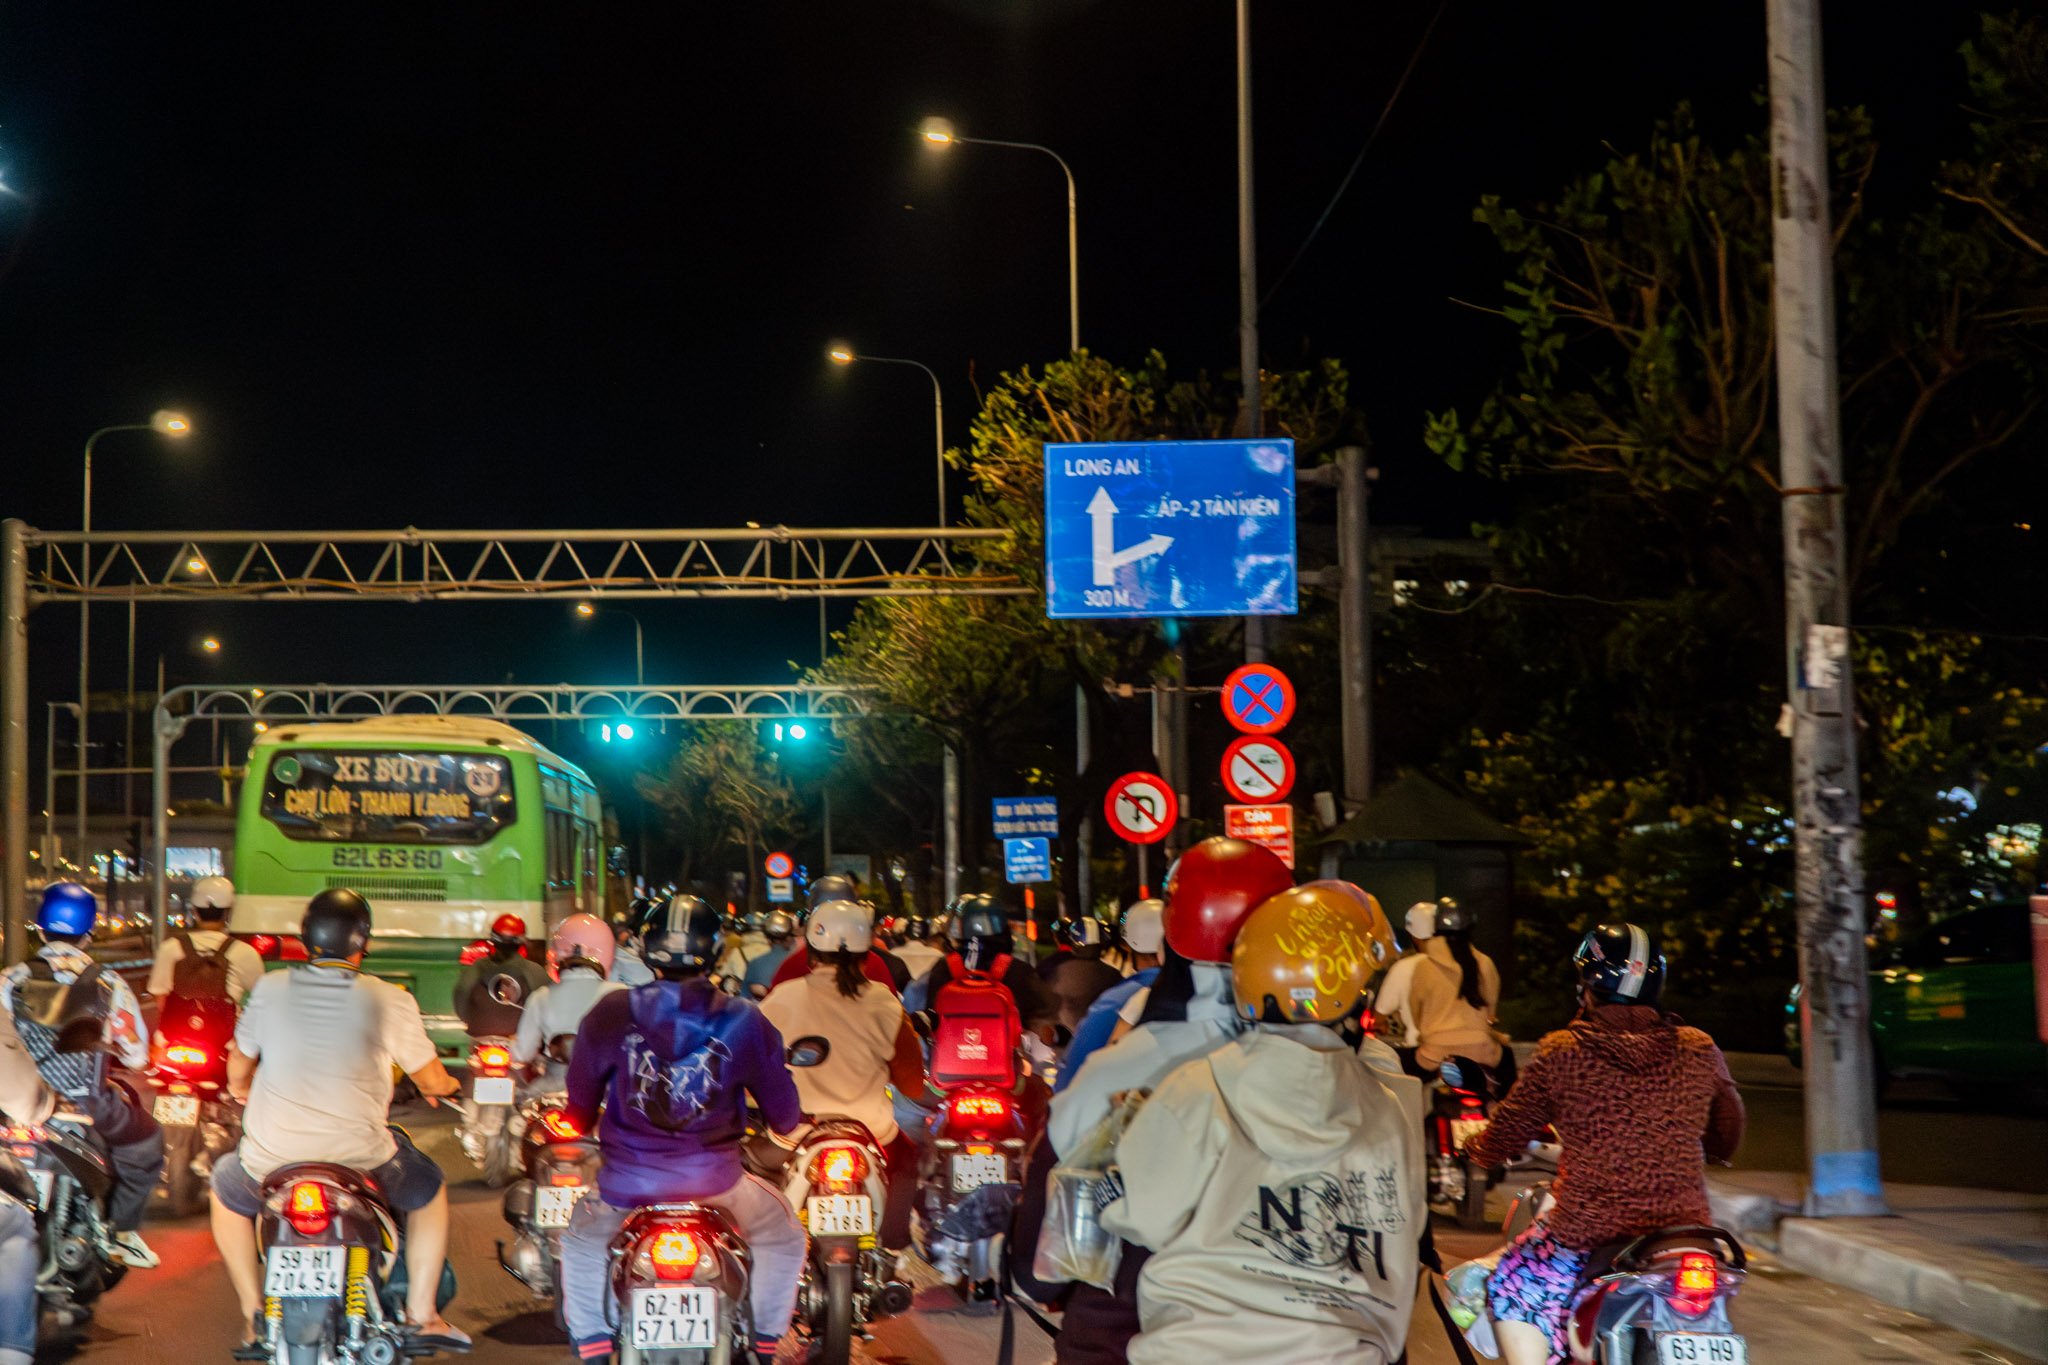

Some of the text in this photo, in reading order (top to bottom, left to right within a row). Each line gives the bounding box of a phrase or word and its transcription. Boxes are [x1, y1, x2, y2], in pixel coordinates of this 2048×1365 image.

[1065, 458, 1141, 477] LONG AN
[1203, 494, 1237, 517] TÂN
[1084, 589, 1112, 608] 300
[333, 756, 371, 782] XE
[1672, 1337, 1733, 1361] 63-H9
